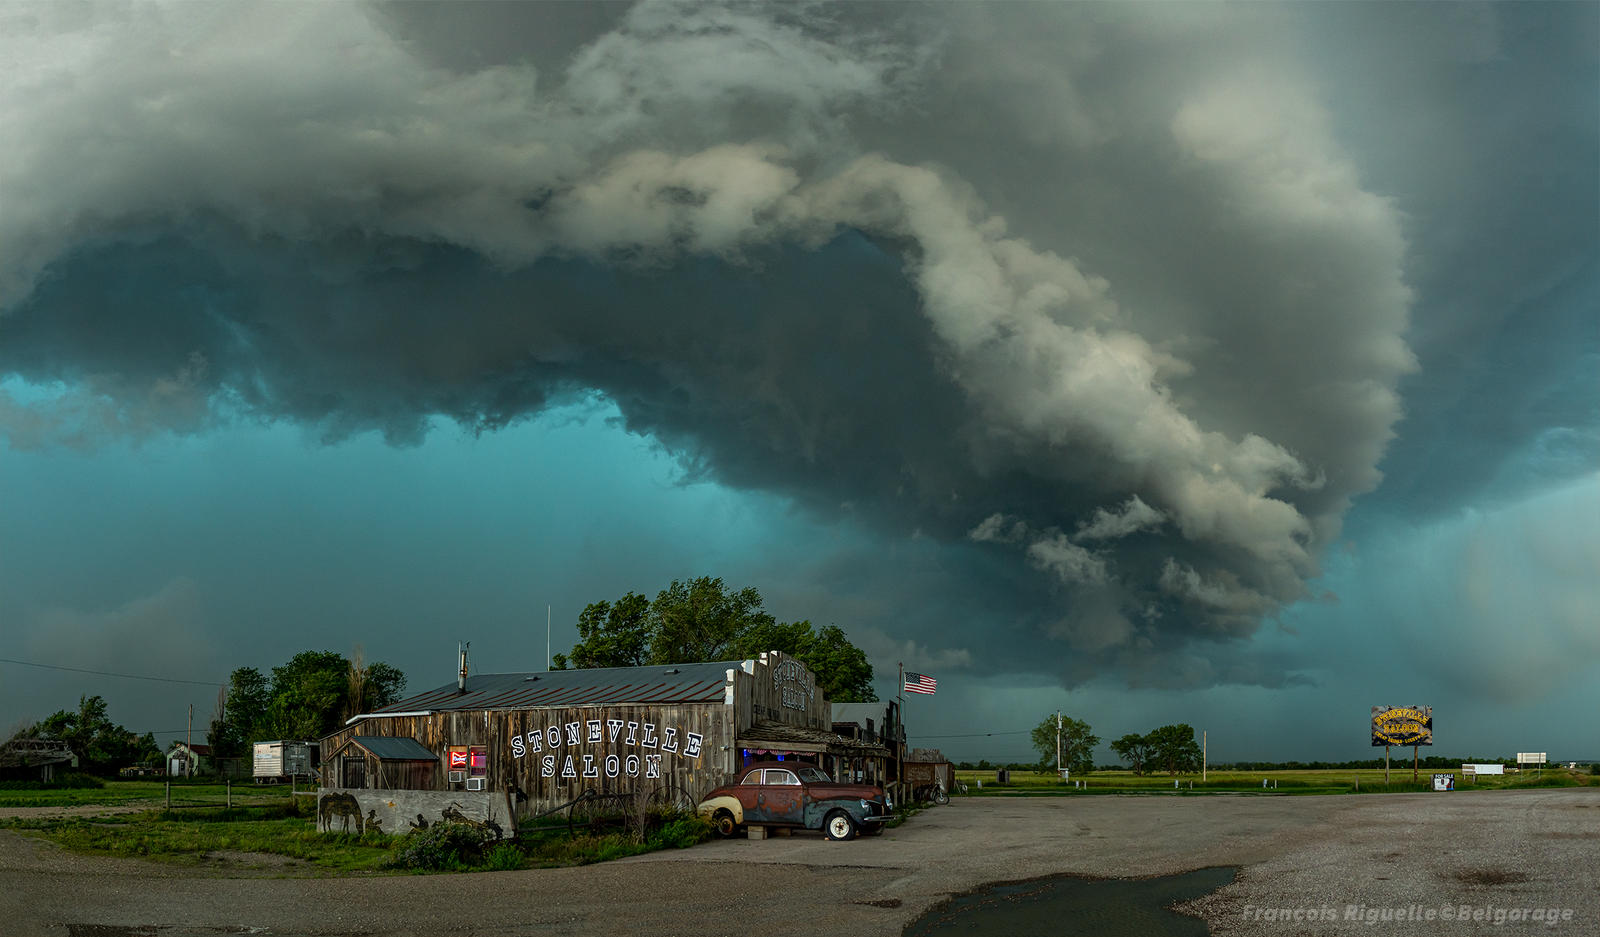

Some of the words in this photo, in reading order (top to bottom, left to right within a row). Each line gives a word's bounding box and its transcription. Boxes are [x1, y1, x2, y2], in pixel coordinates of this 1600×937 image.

[783, 687, 806, 711] SALOON
[1374, 708, 1430, 726] STONEVILLE
[1383, 723, 1419, 733] SALOON
[511, 719, 704, 758] STONEVILLE
[541, 754, 661, 778] SALOON
